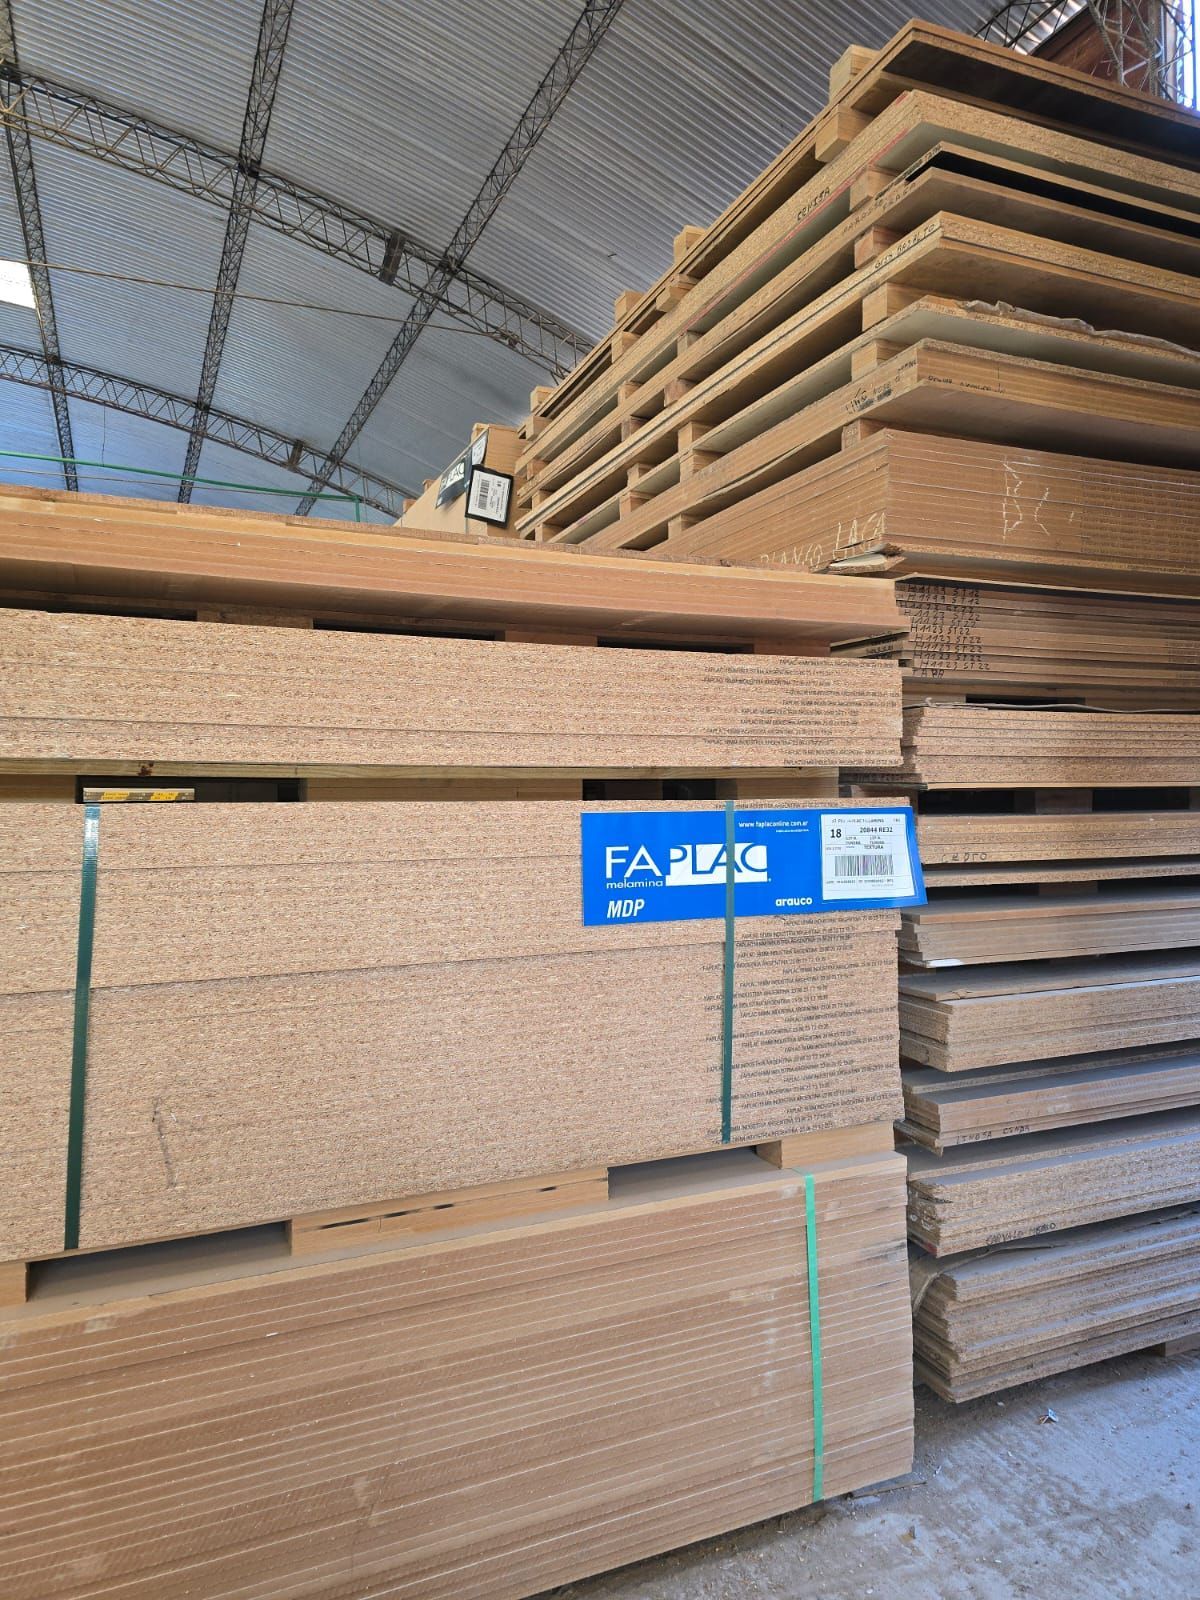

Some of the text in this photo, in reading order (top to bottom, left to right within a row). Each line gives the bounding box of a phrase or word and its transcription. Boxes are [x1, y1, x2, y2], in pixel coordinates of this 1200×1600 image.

[830, 829, 842, 838] 18
[605, 843, 768, 880] FAPLAC
[606, 878, 663, 889] melamina
[775, 896, 812, 907] arauco
[606, 898, 645, 919] MDP
